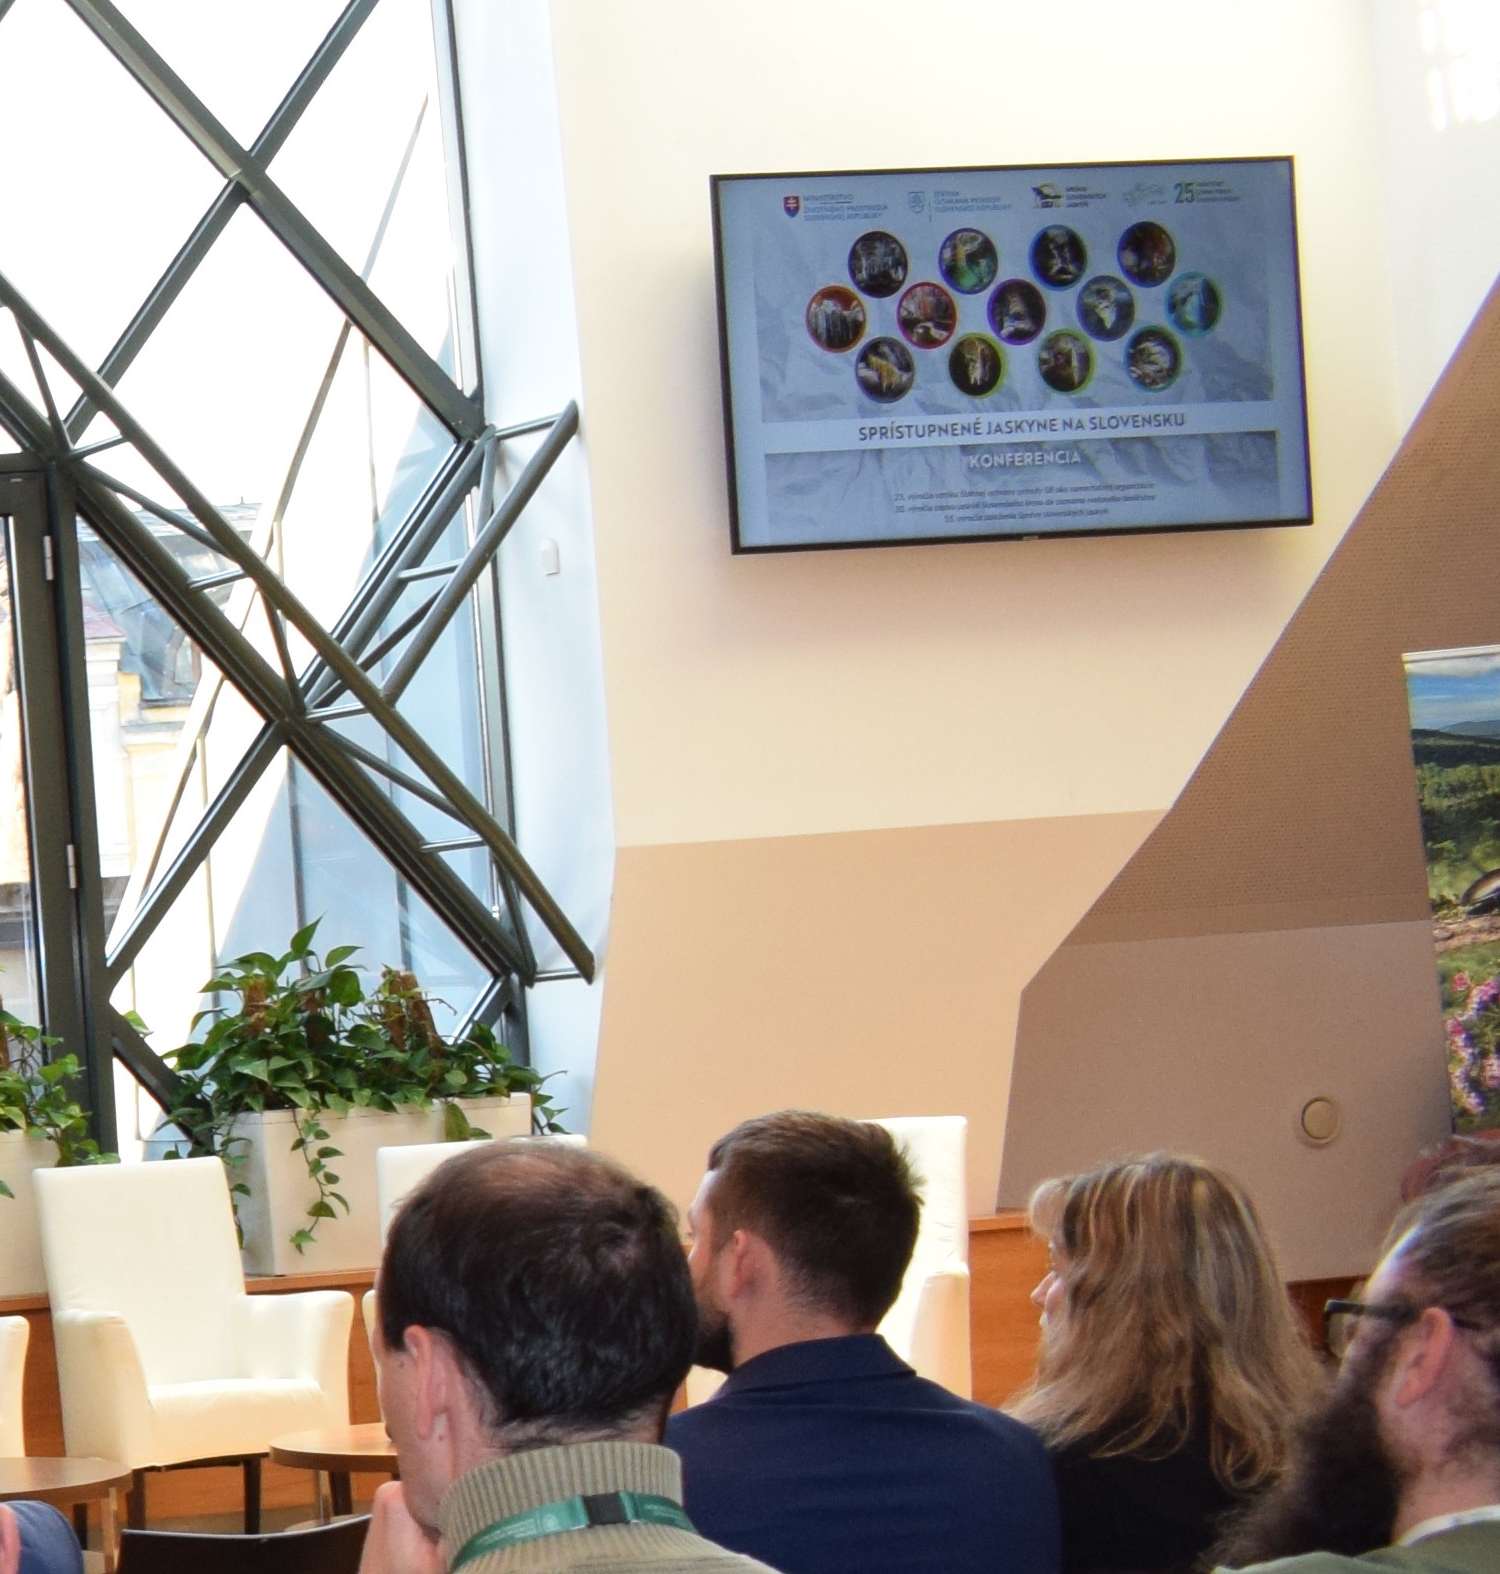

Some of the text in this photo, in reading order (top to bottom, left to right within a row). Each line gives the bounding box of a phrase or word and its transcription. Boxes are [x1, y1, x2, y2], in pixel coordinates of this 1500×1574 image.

[858, 412, 1186, 442] SPRÍSTUPNENÉ JASKYNE NA SLOVENSKU
[968, 449, 1082, 469] KONFERENCIA
